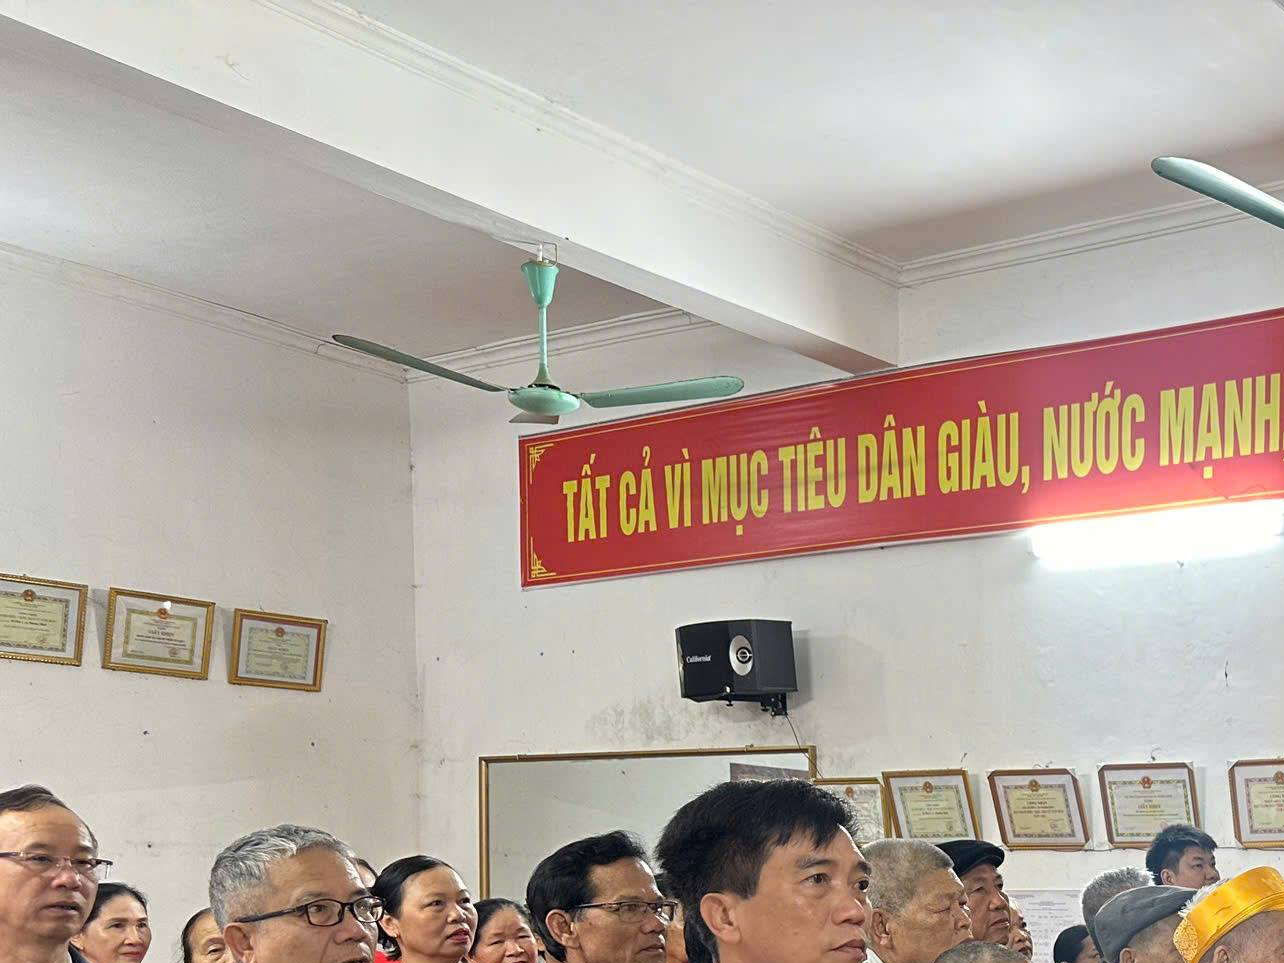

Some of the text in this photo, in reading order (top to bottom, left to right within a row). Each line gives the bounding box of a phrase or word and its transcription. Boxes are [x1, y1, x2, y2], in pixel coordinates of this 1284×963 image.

[563, 454, 610, 542] TẤT
[619, 446, 657, 536] CẢ
[665, 447, 692, 529] VÌ
[702, 448, 768, 536] MỤC
[778, 426, 846, 513] TIÊU
[858, 415, 926, 504] DÂN
[938, 400, 1030, 493] GIÀU,
[1043, 380, 1145, 481] NƯỚC
